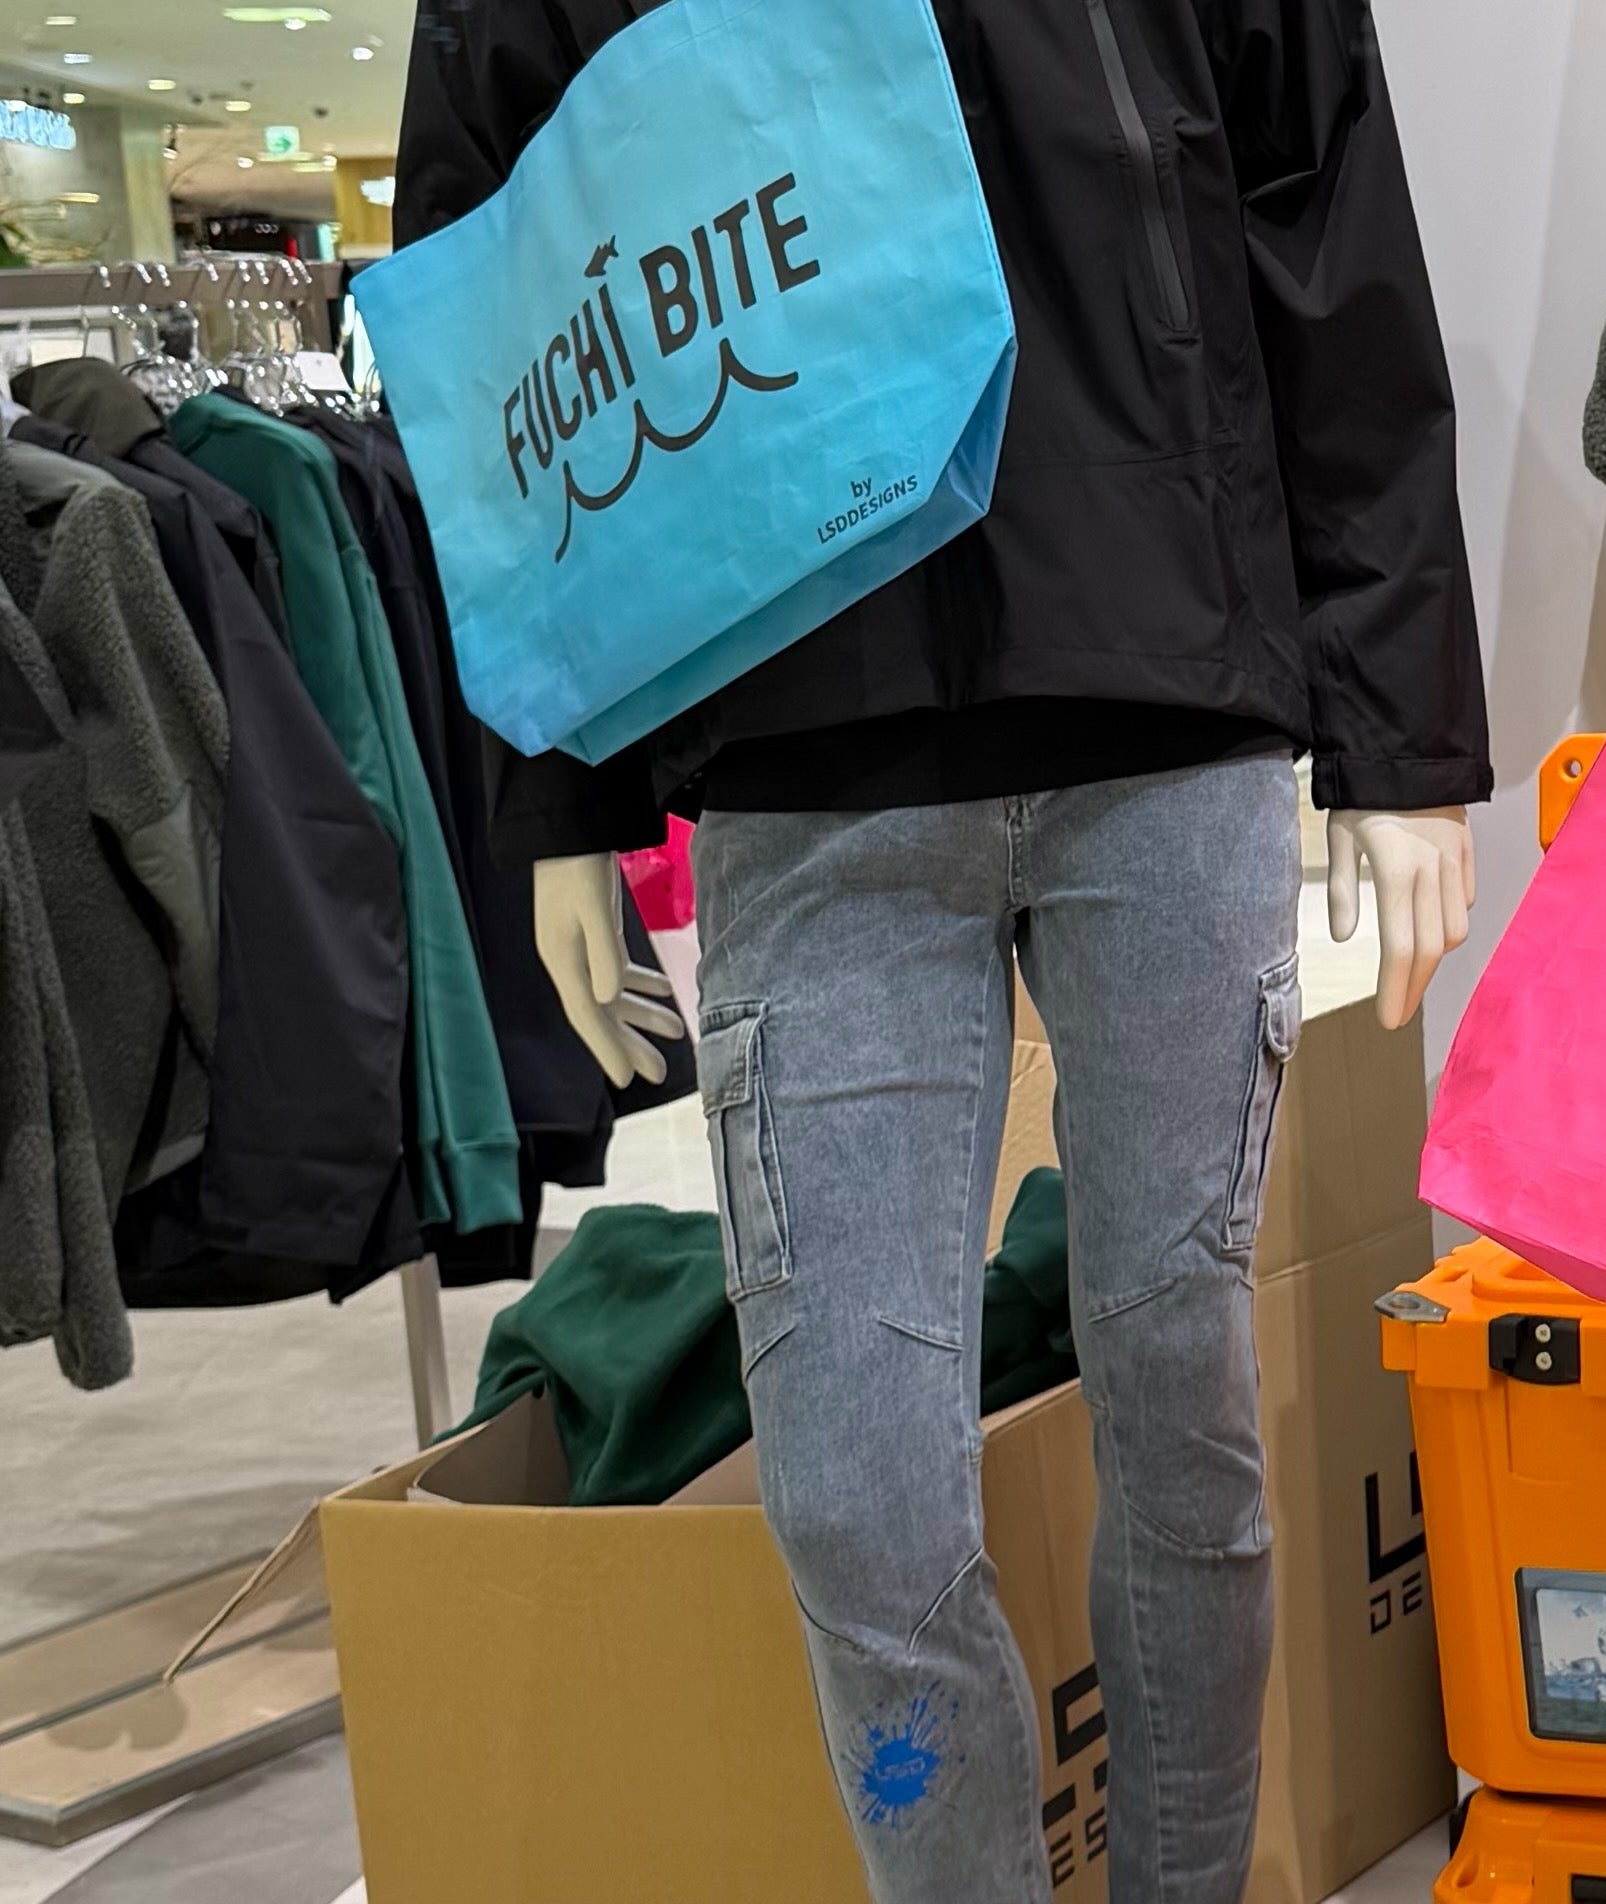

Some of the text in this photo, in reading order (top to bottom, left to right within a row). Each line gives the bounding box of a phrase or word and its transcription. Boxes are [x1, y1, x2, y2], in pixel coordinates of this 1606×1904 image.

[503, 172, 821, 499] FUCHI BITE
[817, 474, 918, 544] LSDDESIGNS
[850, 477, 872, 498] by
